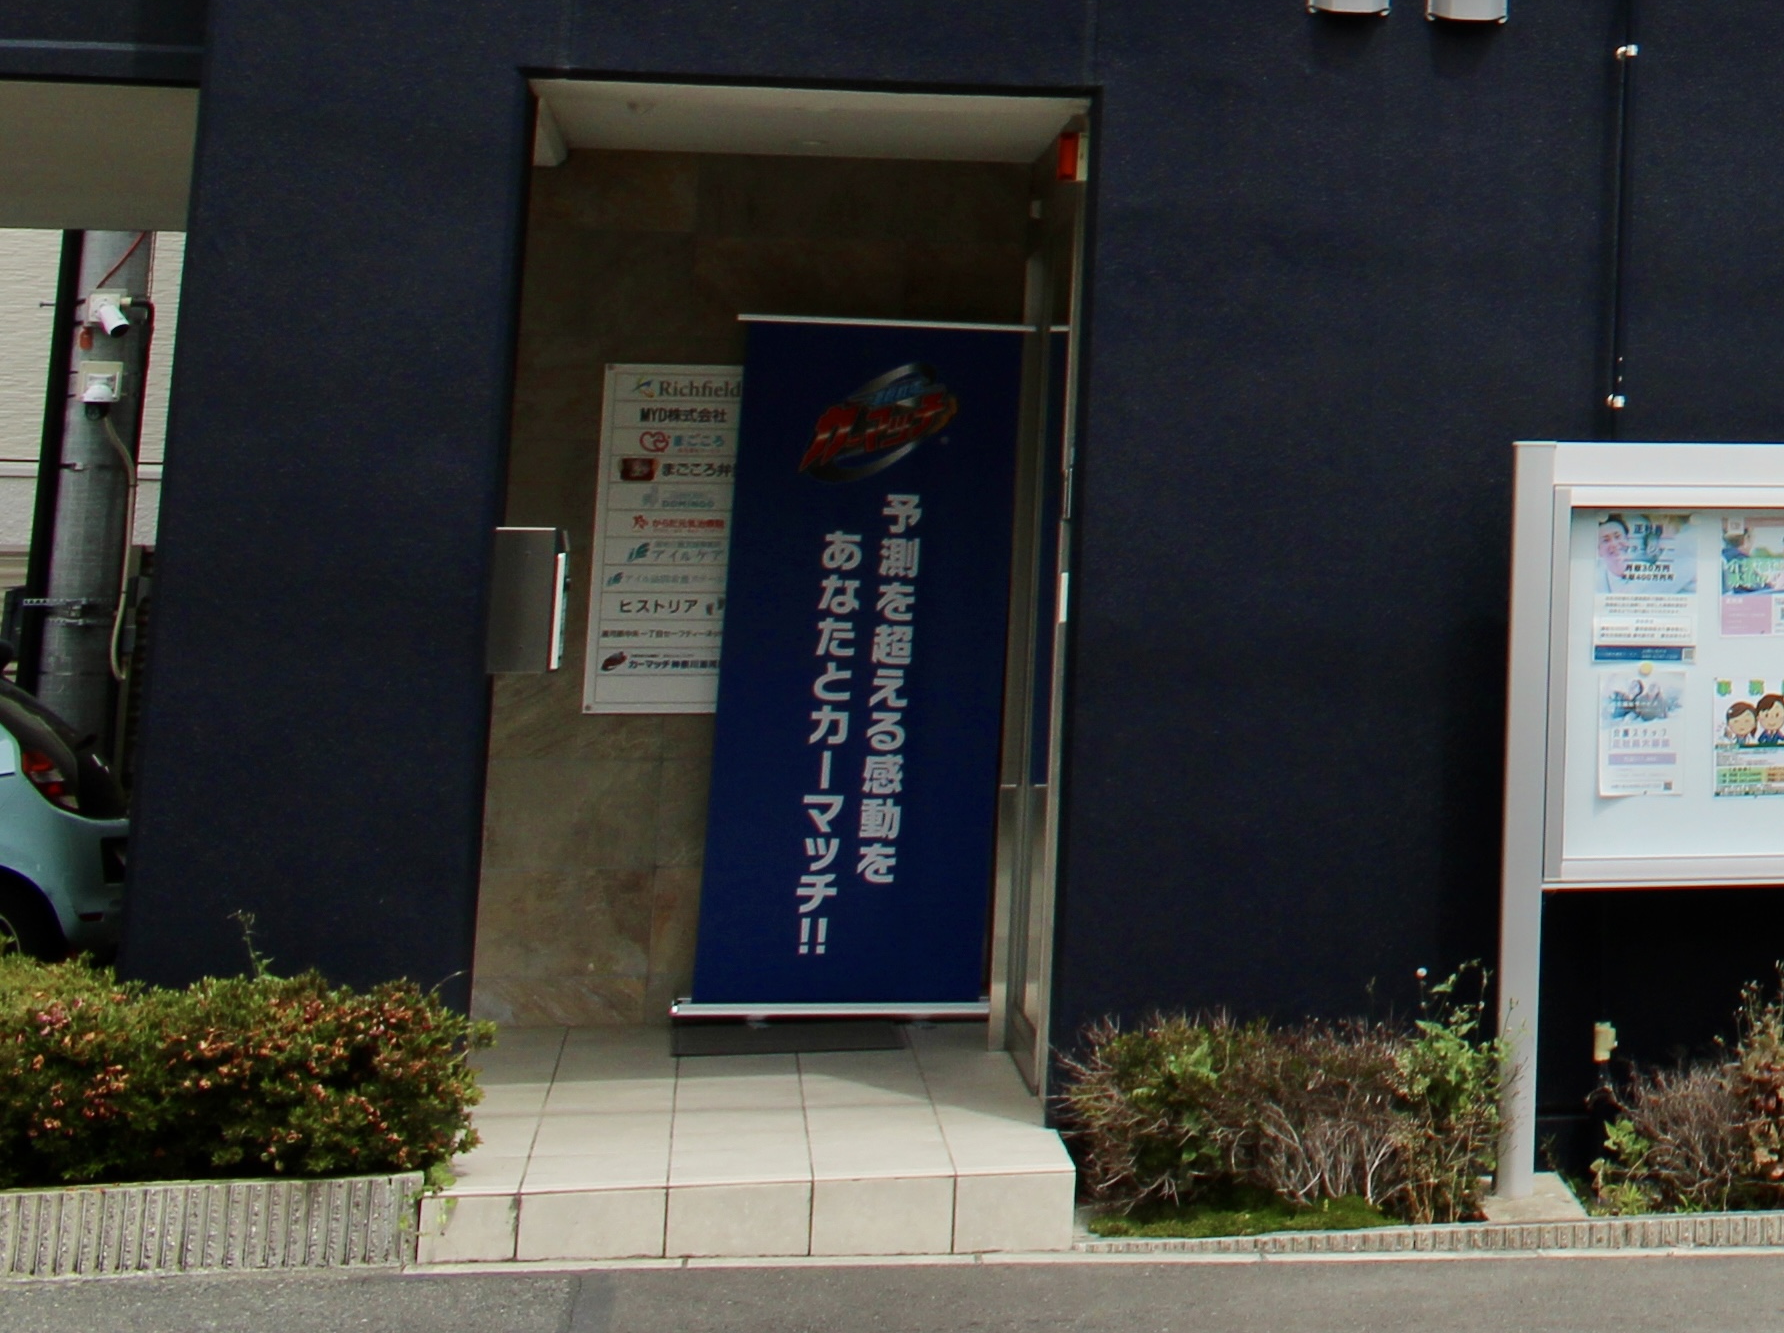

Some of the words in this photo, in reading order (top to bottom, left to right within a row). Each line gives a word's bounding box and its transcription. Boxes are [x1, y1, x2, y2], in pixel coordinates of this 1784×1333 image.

[659, 379, 742, 398] Richfield
[640, 407, 727, 423] MYD株式会社
[673, 435, 724, 448] まごころ
[662, 463, 737, 478] まごころ弁
[619, 599, 698, 614] ヒストリア
[857, 493, 922, 884] 予測を超える感動を
[796, 530, 862, 955] あなたとカーマッチ!!
